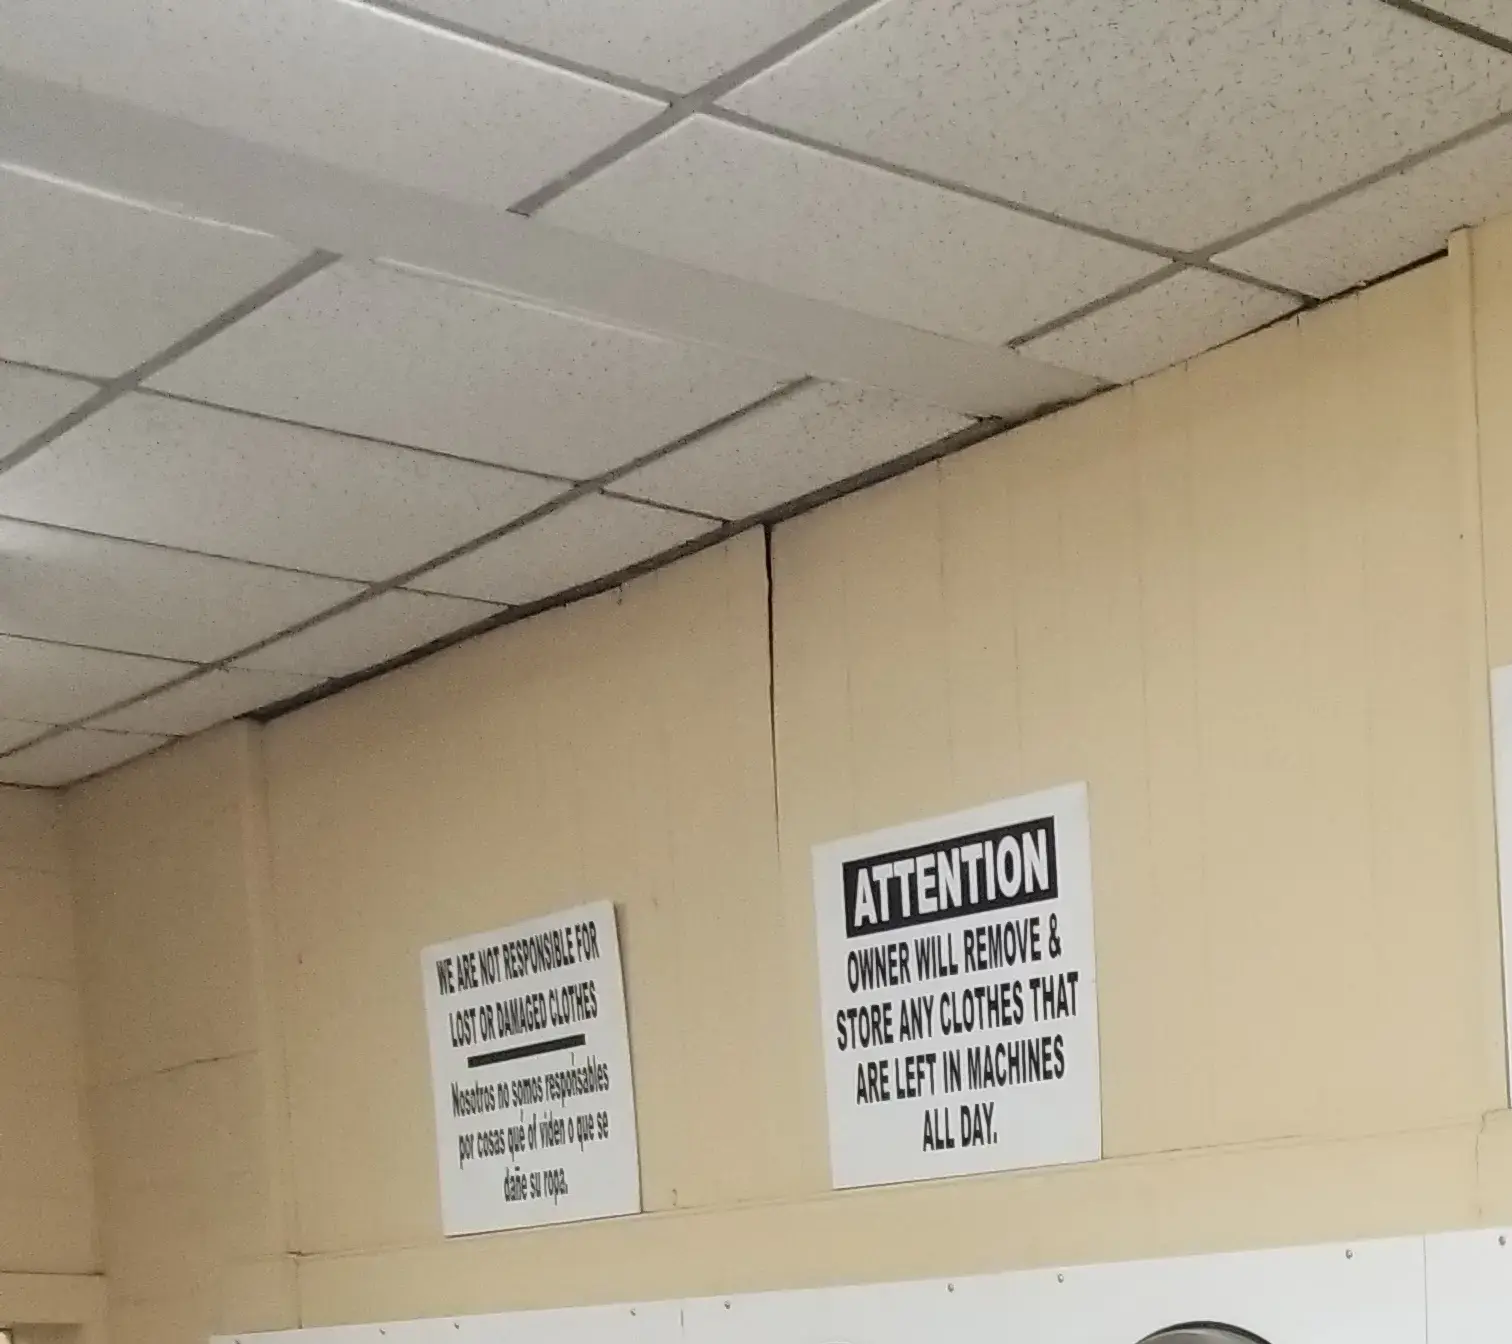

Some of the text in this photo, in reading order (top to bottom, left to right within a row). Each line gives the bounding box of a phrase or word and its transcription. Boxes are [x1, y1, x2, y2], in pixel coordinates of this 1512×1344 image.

[854, 829, 1049, 927] ATTENTION
[436, 920, 600, 995] WE ARE NOT RESPONSIBLE FOR
[847, 913, 1061, 993] OWNER WILL REMOVE &
[449, 980, 598, 1047] LOST OR DAMAGED CLOTHES
[837, 971, 1078, 1051] STORE ANY CLOTHES THAT
[451, 1080, 495, 1118] Nosotros
[497, 1082, 509, 1109] no
[512, 1076, 543, 1107] somos
[857, 1034, 1064, 1104] ARE LEFT IN MACHINES
[459, 1134, 474, 1170] por
[577, 1114, 594, 1152] que
[597, 1111, 609, 1140] se
[923, 1102, 998, 1151] ALL DAY.
[530, 1172, 541, 1199] su
